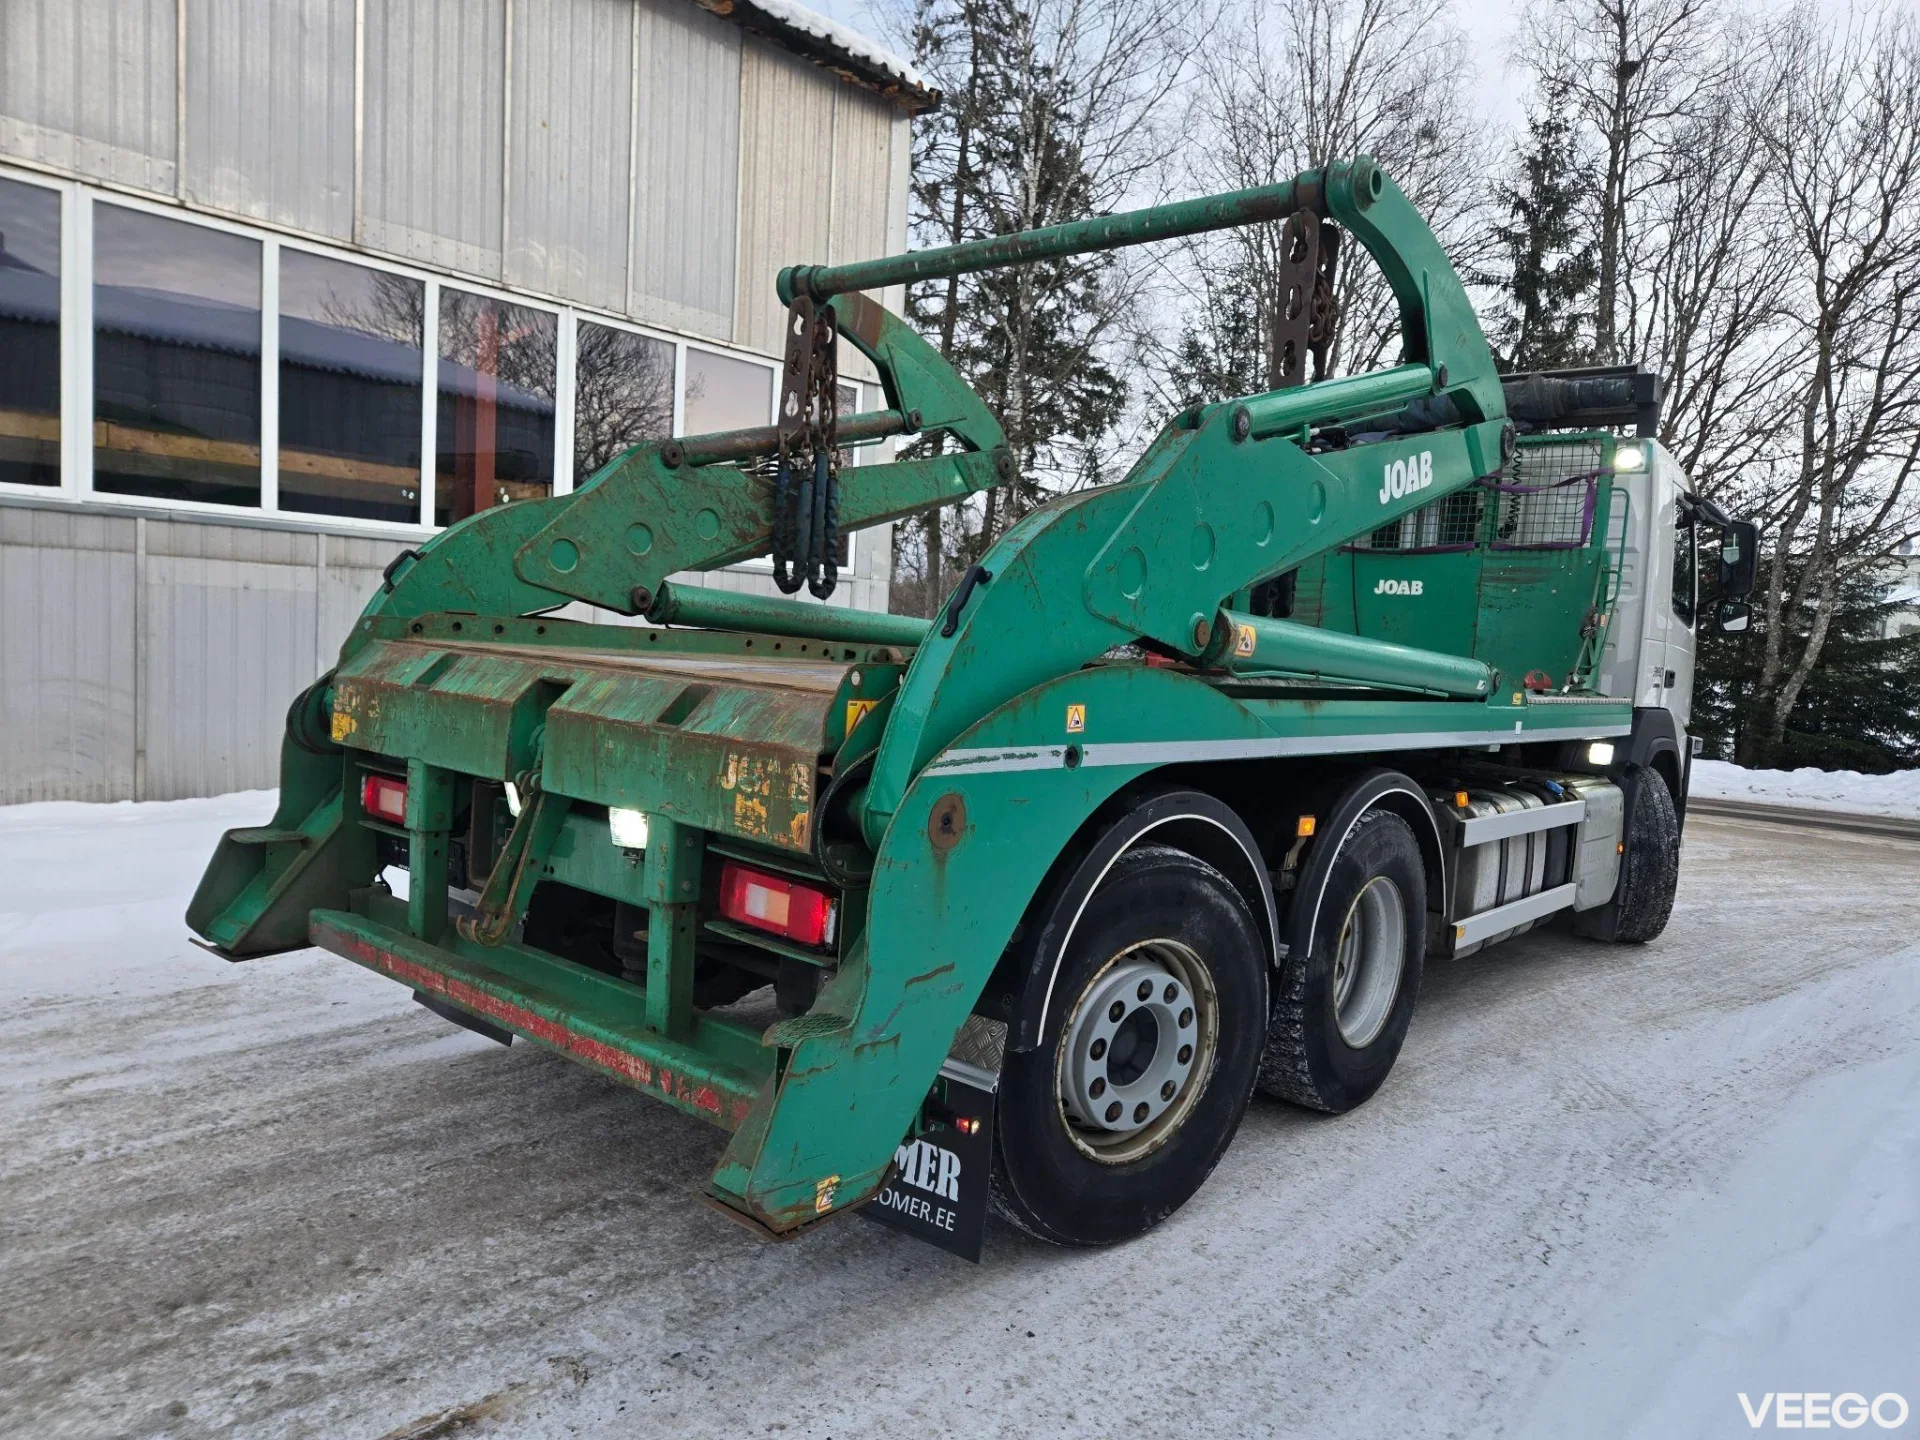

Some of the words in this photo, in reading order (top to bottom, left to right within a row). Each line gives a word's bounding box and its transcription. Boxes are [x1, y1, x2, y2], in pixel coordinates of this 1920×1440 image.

[1379, 451, 1433, 505] JOAB
[1374, 579, 1423, 595] JOAB
[872, 1187, 957, 1232] OMER.EE
